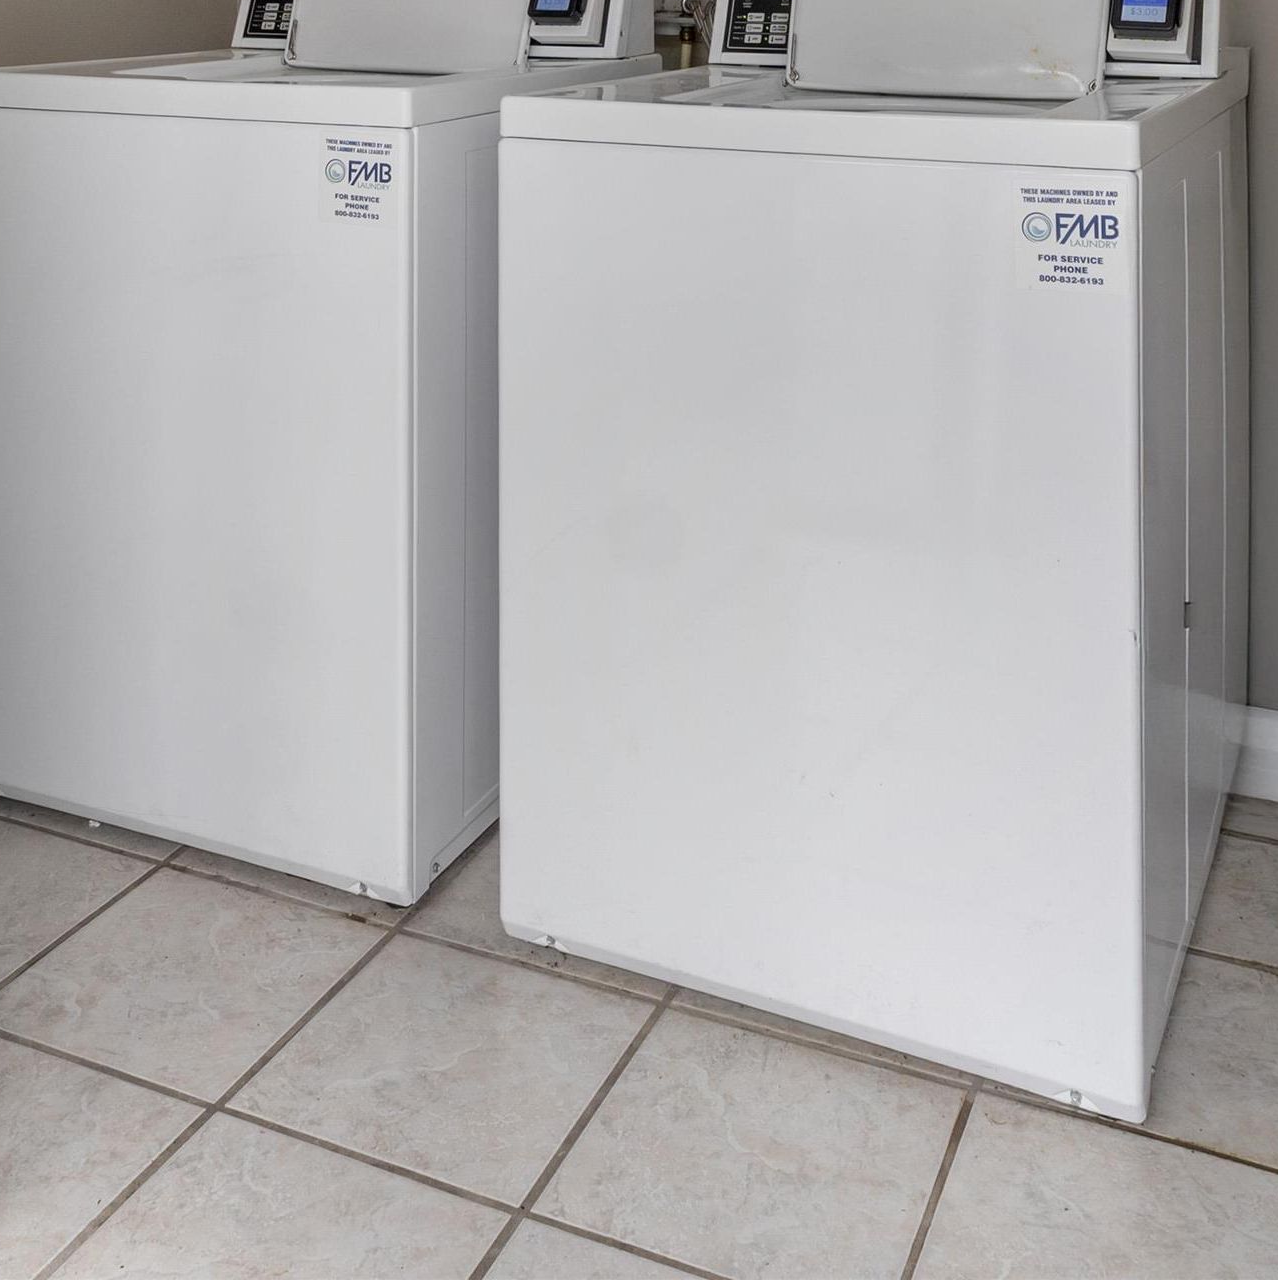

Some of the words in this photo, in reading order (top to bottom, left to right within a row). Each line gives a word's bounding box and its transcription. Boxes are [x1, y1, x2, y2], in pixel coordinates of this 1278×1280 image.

[348, 160, 392, 186] FMB
[358, 182, 391, 190] LAUNDRY
[351, 195, 380, 203] SERVICE
[345, 202, 369, 210] PHONE
[334, 210, 379, 220] 800-832-6193
[1055, 213, 1119, 245] FMB
[1070, 240, 1117, 249] LAUNDRY
[1038, 254, 1058, 262] FOR
[1061, 255, 1103, 264] SERVICE
[1053, 265, 1088, 274] PHONE
[1039, 275, 1104, 285] 800-832-6193
